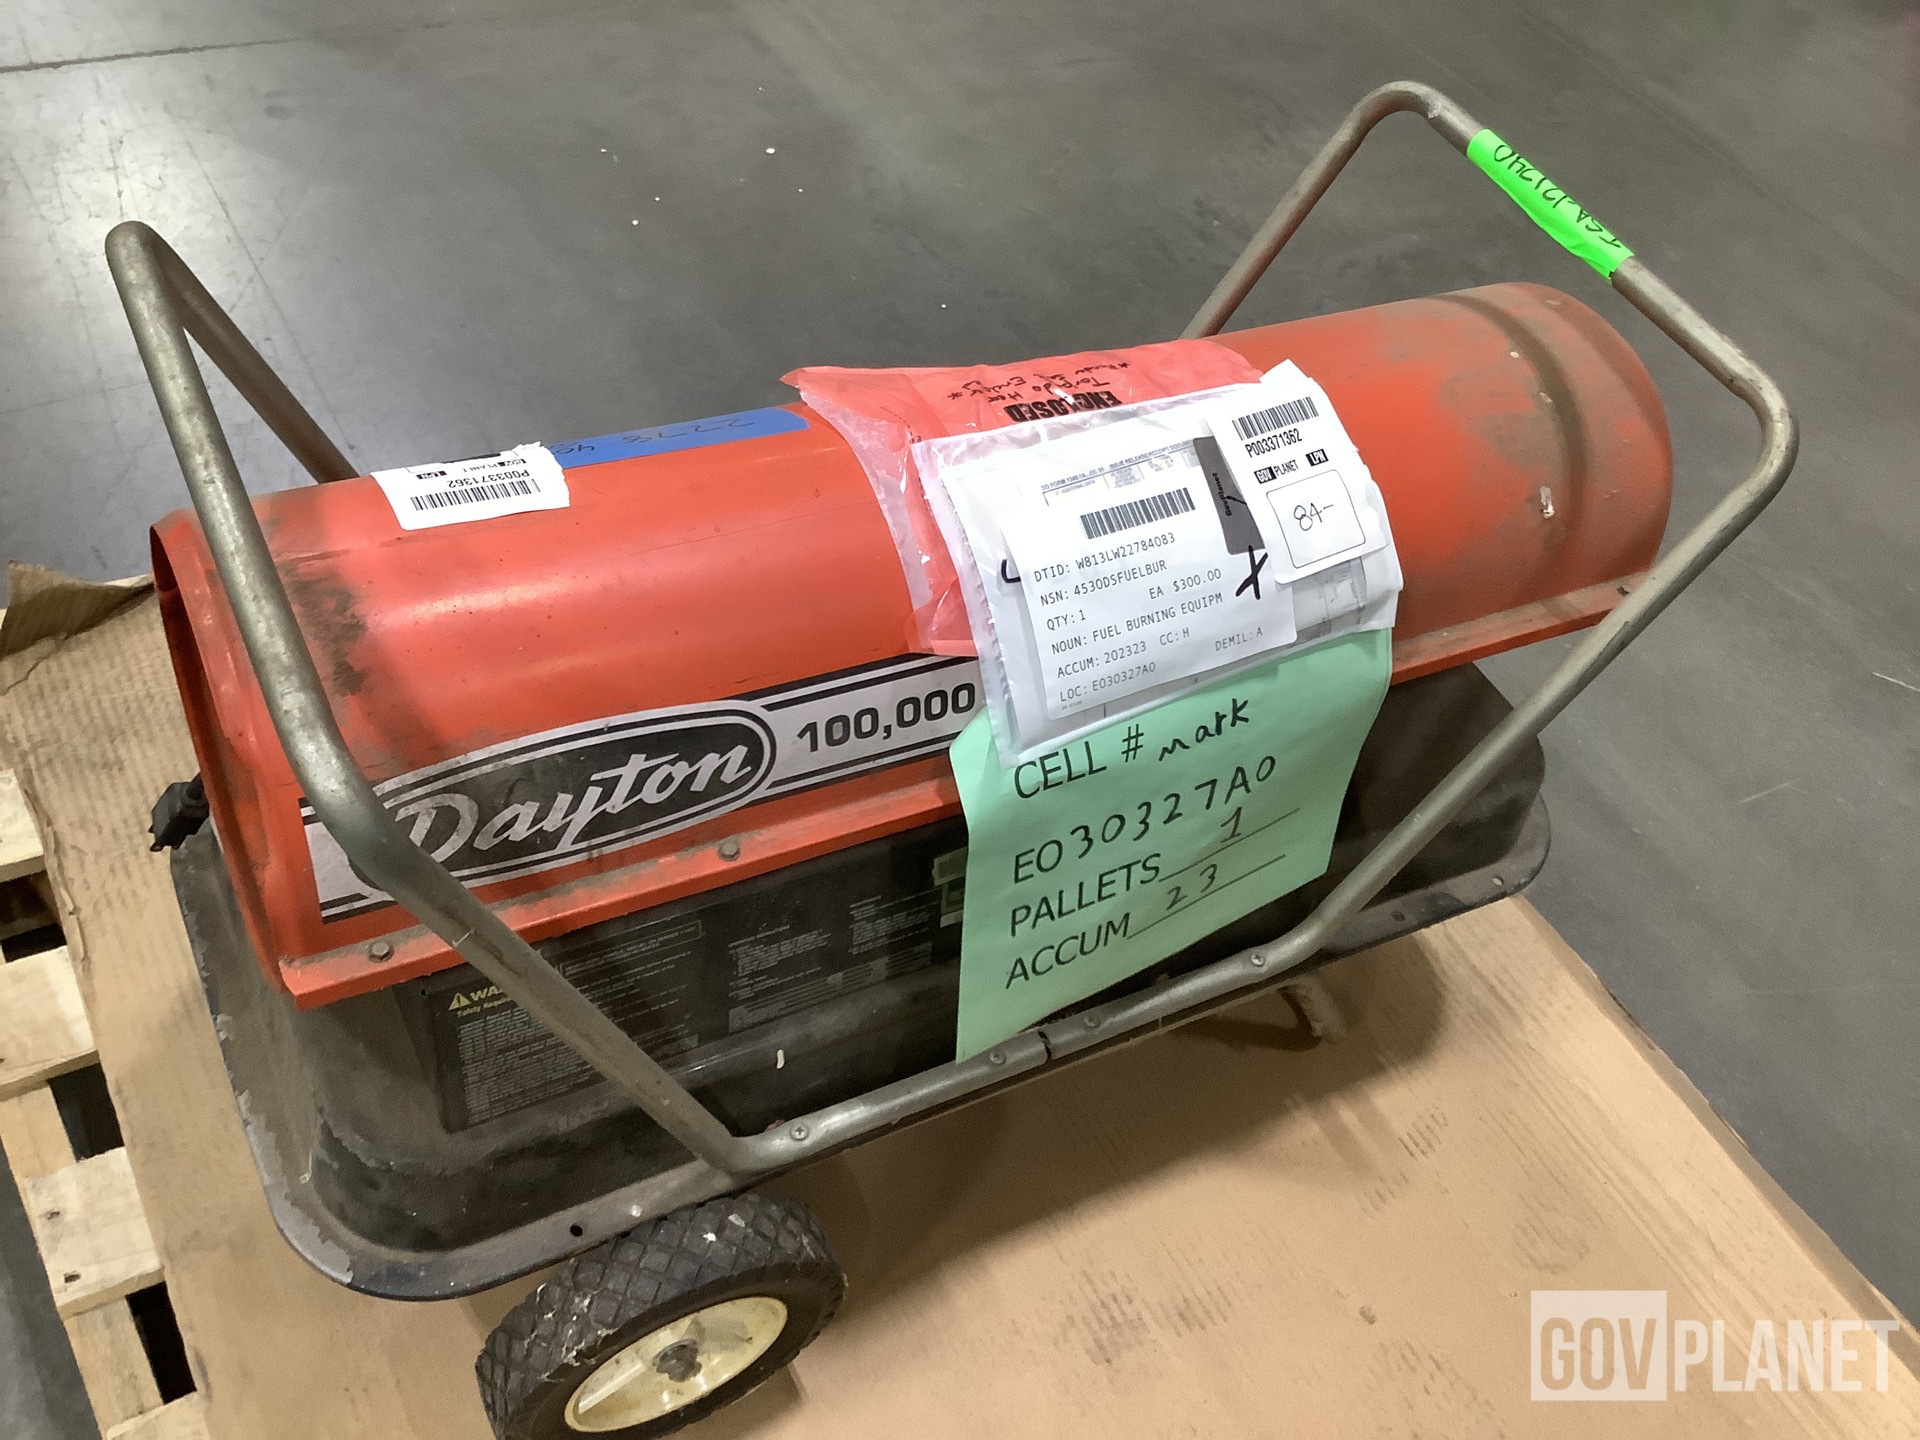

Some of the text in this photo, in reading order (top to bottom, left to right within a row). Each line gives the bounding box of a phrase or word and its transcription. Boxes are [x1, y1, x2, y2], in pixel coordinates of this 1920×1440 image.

[1245, 428, 1303, 458] P003371362
[446, 469, 530, 488] P003371362
[1274, 459, 1300, 477] PLANET
[1033, 533, 1176, 582] DTID: W813LW22784083
[1040, 590, 1069, 606] NSN:
[1046, 568, 1221, 631] QTY: 1 EA $300.00
[1051, 592, 1223, 655] NOUN: FUEL BURNING EQUIPM
[1057, 657, 1100, 678] ACCUM:
[1104, 641, 1147, 664] 202323
[1060, 686, 1087, 702] LOC:
[394, 682, 975, 863] Dayton 100,000
[1013, 740, 1107, 799] CELL
[1121, 723, 1145, 763] #
[1010, 853, 1161, 938] PALLETS
[1005, 912, 1131, 990] ACCUM
